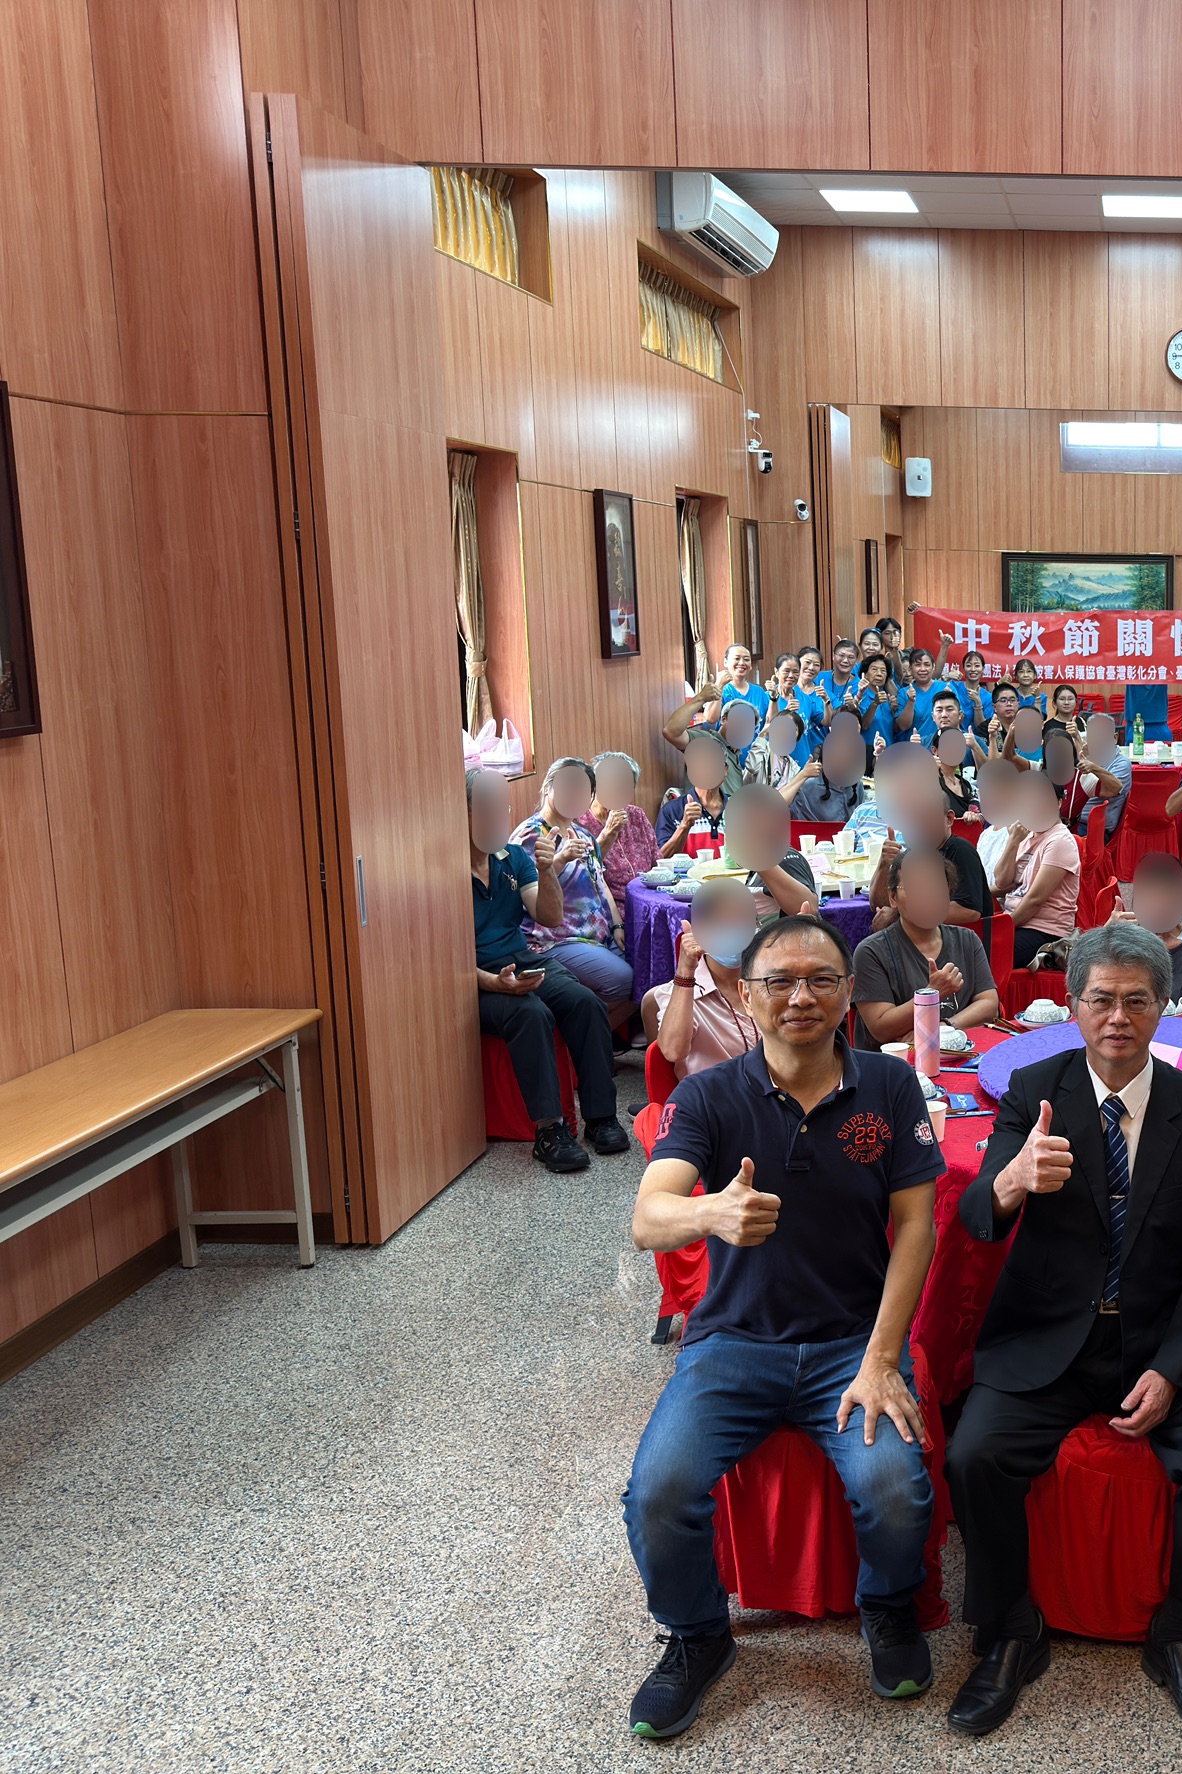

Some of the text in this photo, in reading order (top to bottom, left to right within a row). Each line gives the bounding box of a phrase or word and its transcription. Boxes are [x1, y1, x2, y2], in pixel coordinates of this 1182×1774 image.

[1174, 343, 1182, 351] 10
[1172, 352, 1177, 360] 9
[1175, 361, 1180, 369] 8
[837, 1112, 892, 1140] SUPERDRY
[855, 1126, 877, 1145] 23
